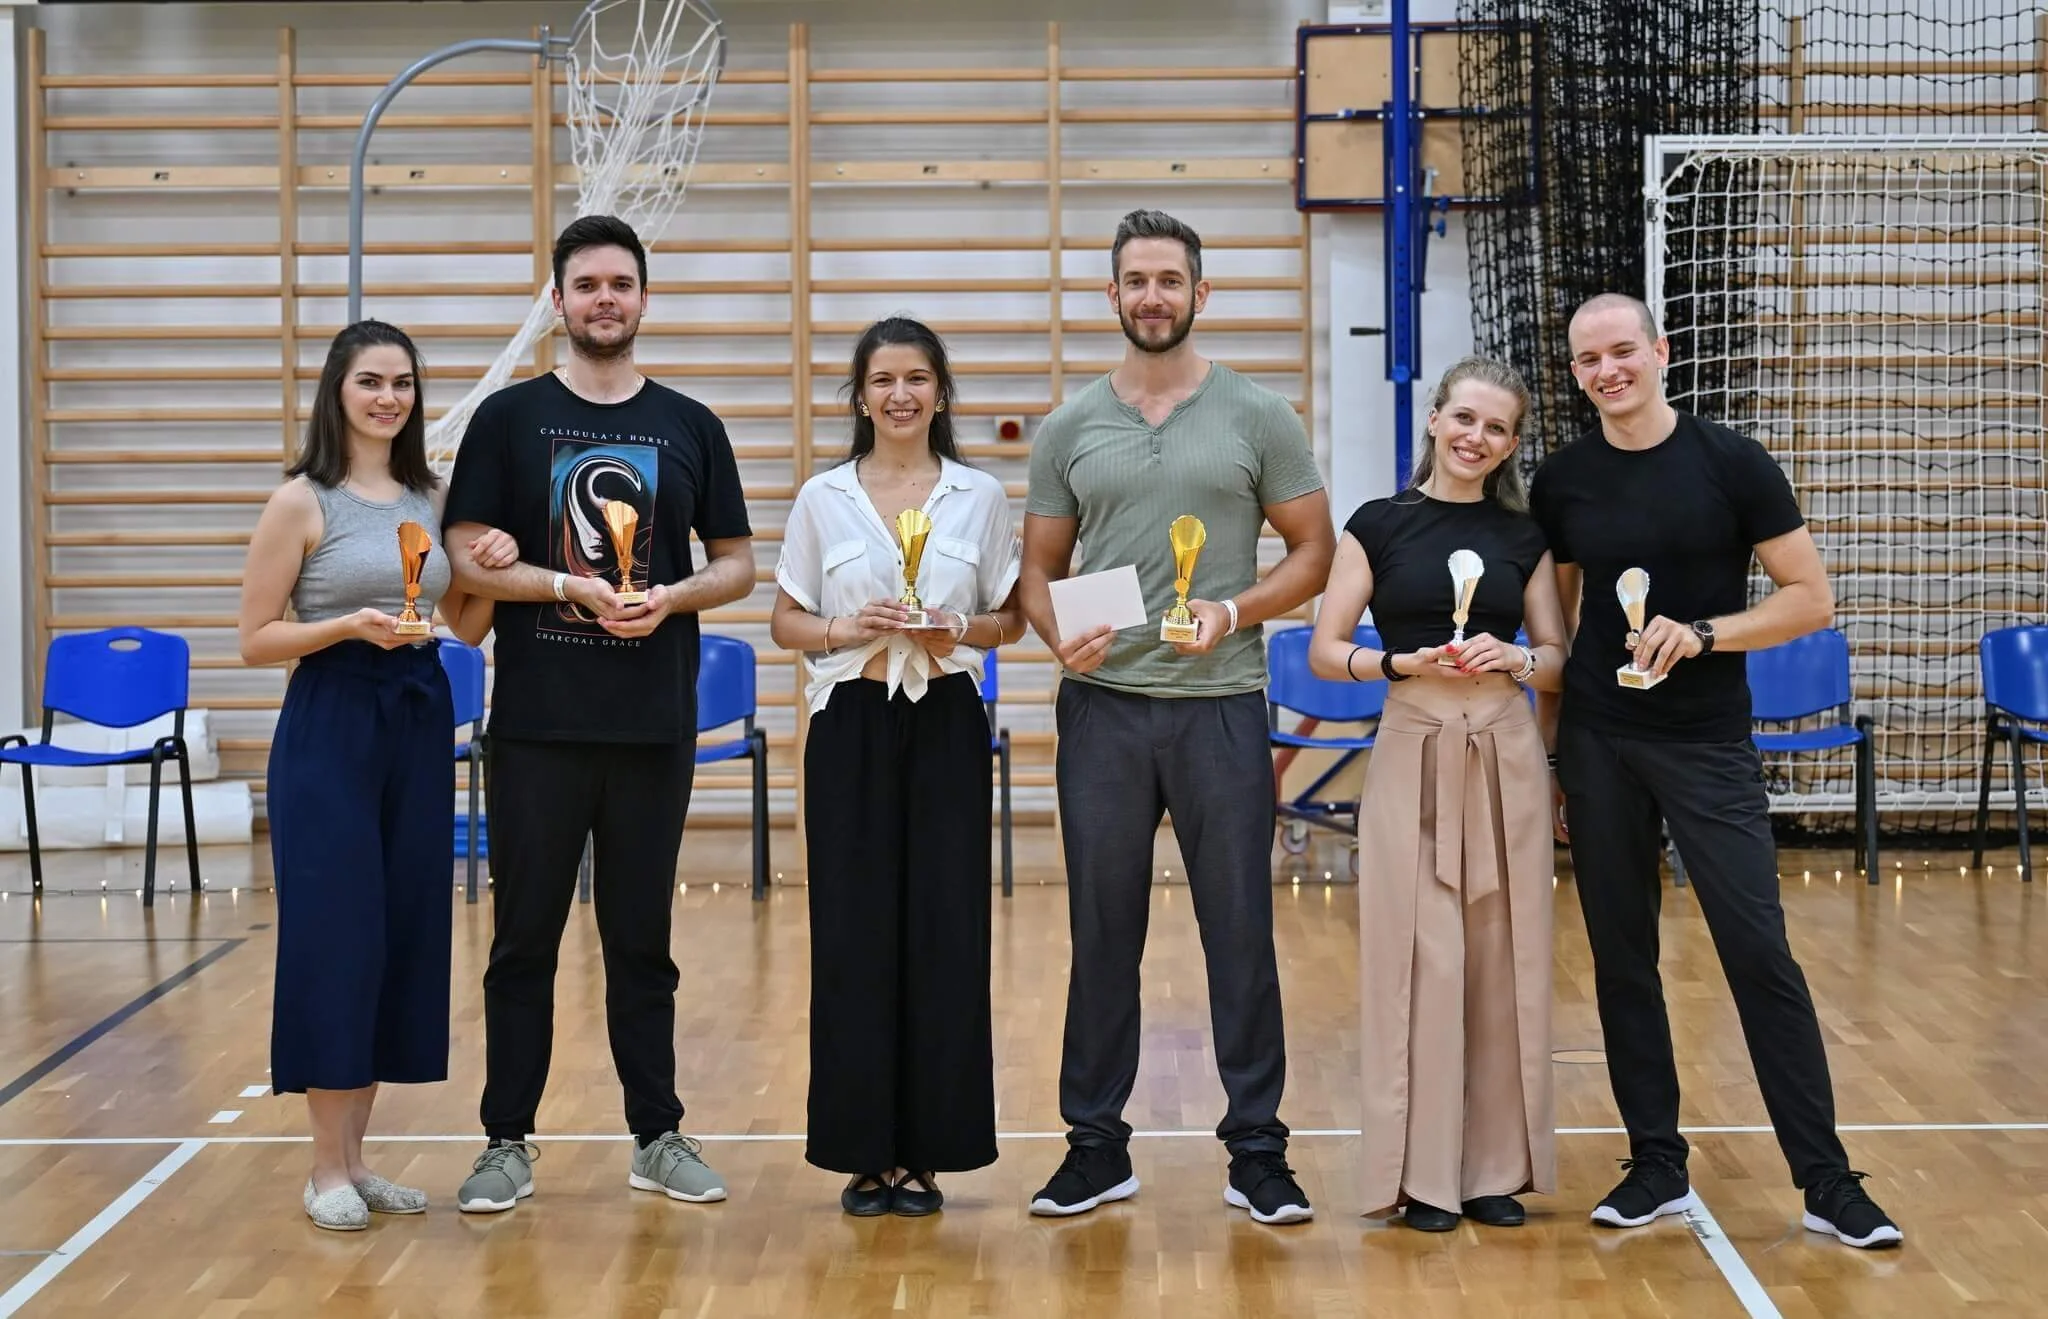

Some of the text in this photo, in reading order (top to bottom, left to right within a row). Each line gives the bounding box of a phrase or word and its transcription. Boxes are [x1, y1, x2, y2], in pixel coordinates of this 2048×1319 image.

[540, 427, 669, 446] CALIGULA'S HORSE
[536, 632, 641, 647] CHARCOAL GRACE
